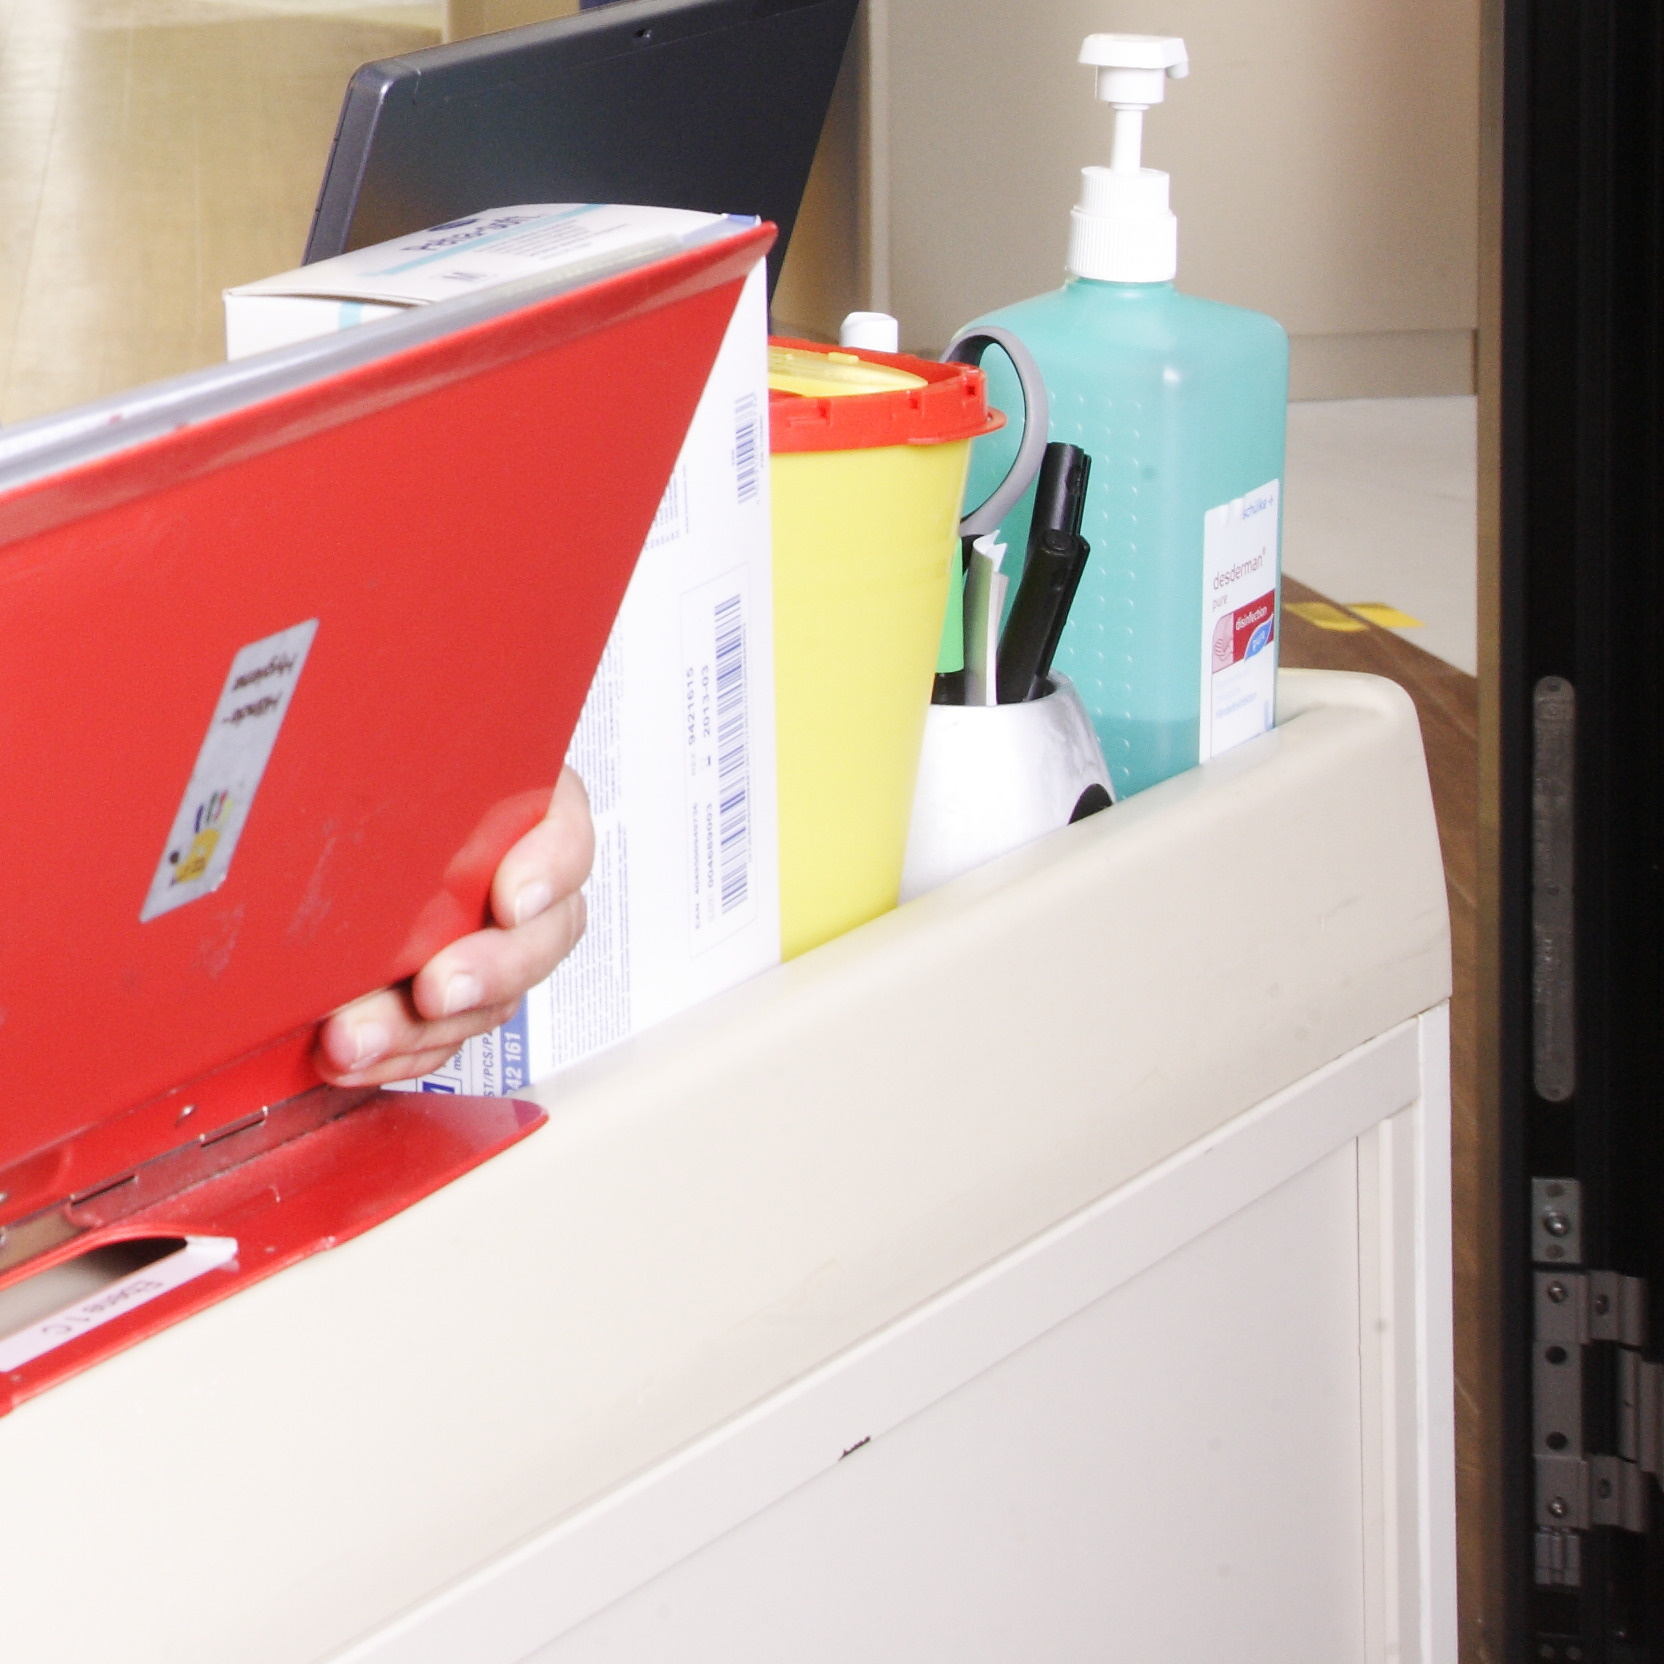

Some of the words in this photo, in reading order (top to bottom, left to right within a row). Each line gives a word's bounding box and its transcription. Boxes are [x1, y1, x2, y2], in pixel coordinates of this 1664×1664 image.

[686, 666, 697, 746] 9421615
[700, 664, 711, 738] 2013-03
[505, 1032, 521, 1062] 161
[504, 1067, 522, 1093] 42
